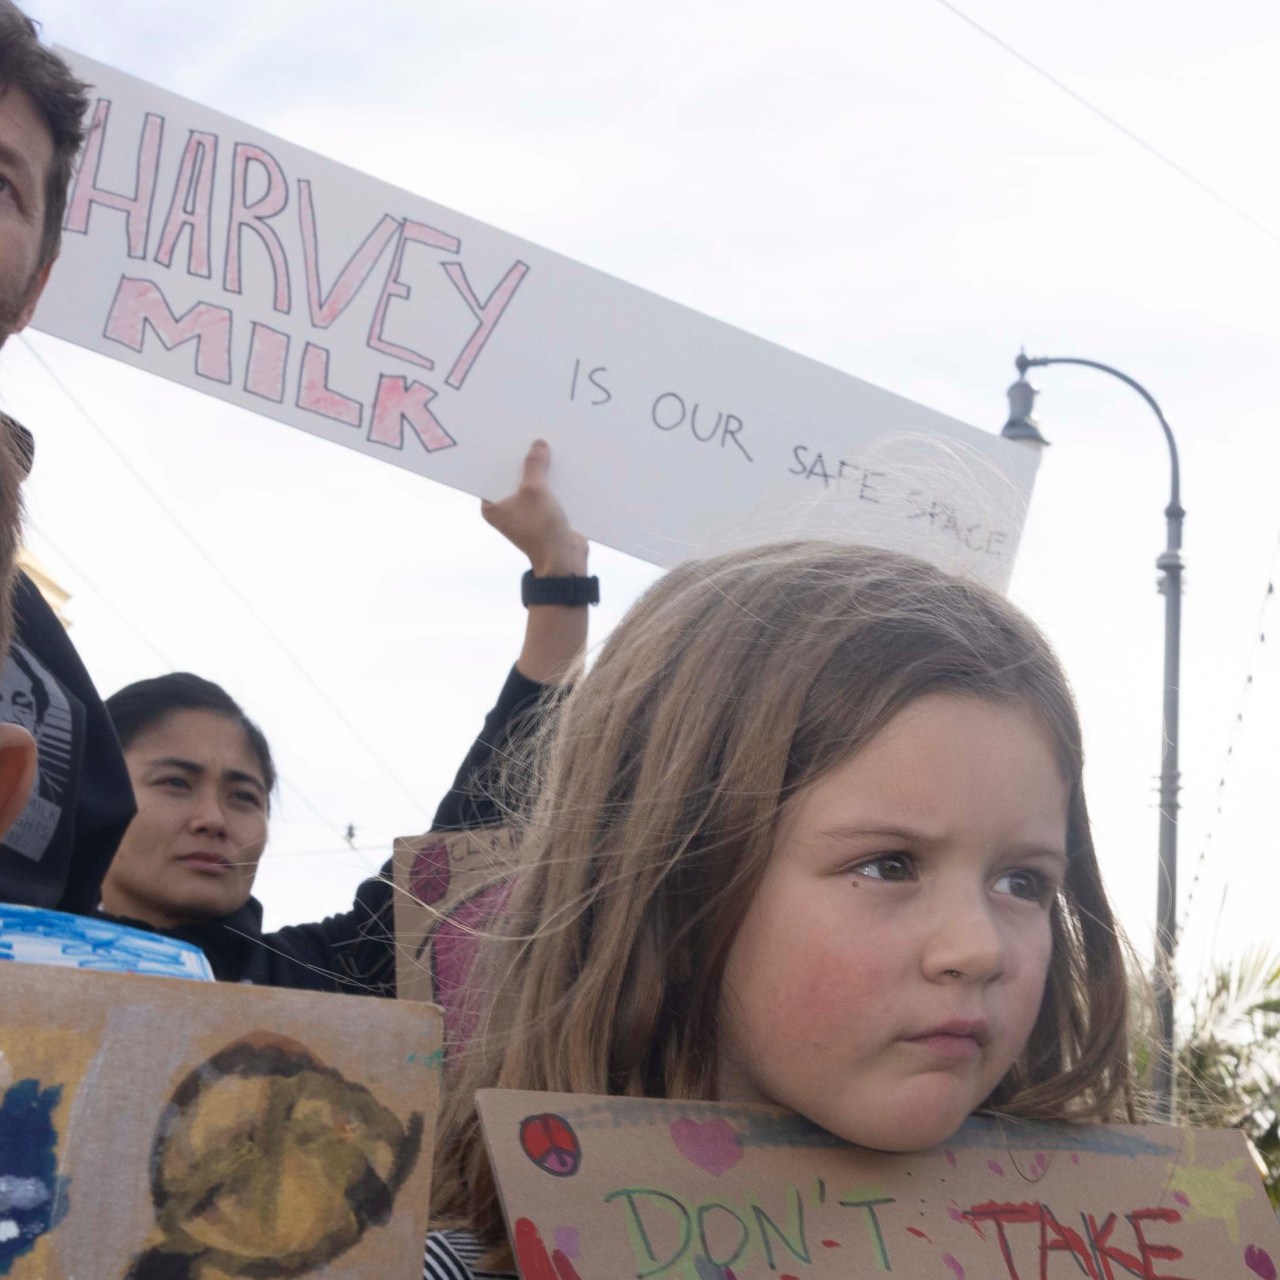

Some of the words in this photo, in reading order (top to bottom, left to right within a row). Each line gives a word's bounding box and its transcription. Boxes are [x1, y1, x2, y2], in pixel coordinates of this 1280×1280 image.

[63, 98, 529, 389] HARVEY
[103, 274, 457, 453] MILK
[570, 359, 612, 405] IS
[652, 392, 754, 463] OUR
[788, 445, 887, 503] SAFE
[603, 1179, 896, 1279] DON'T
